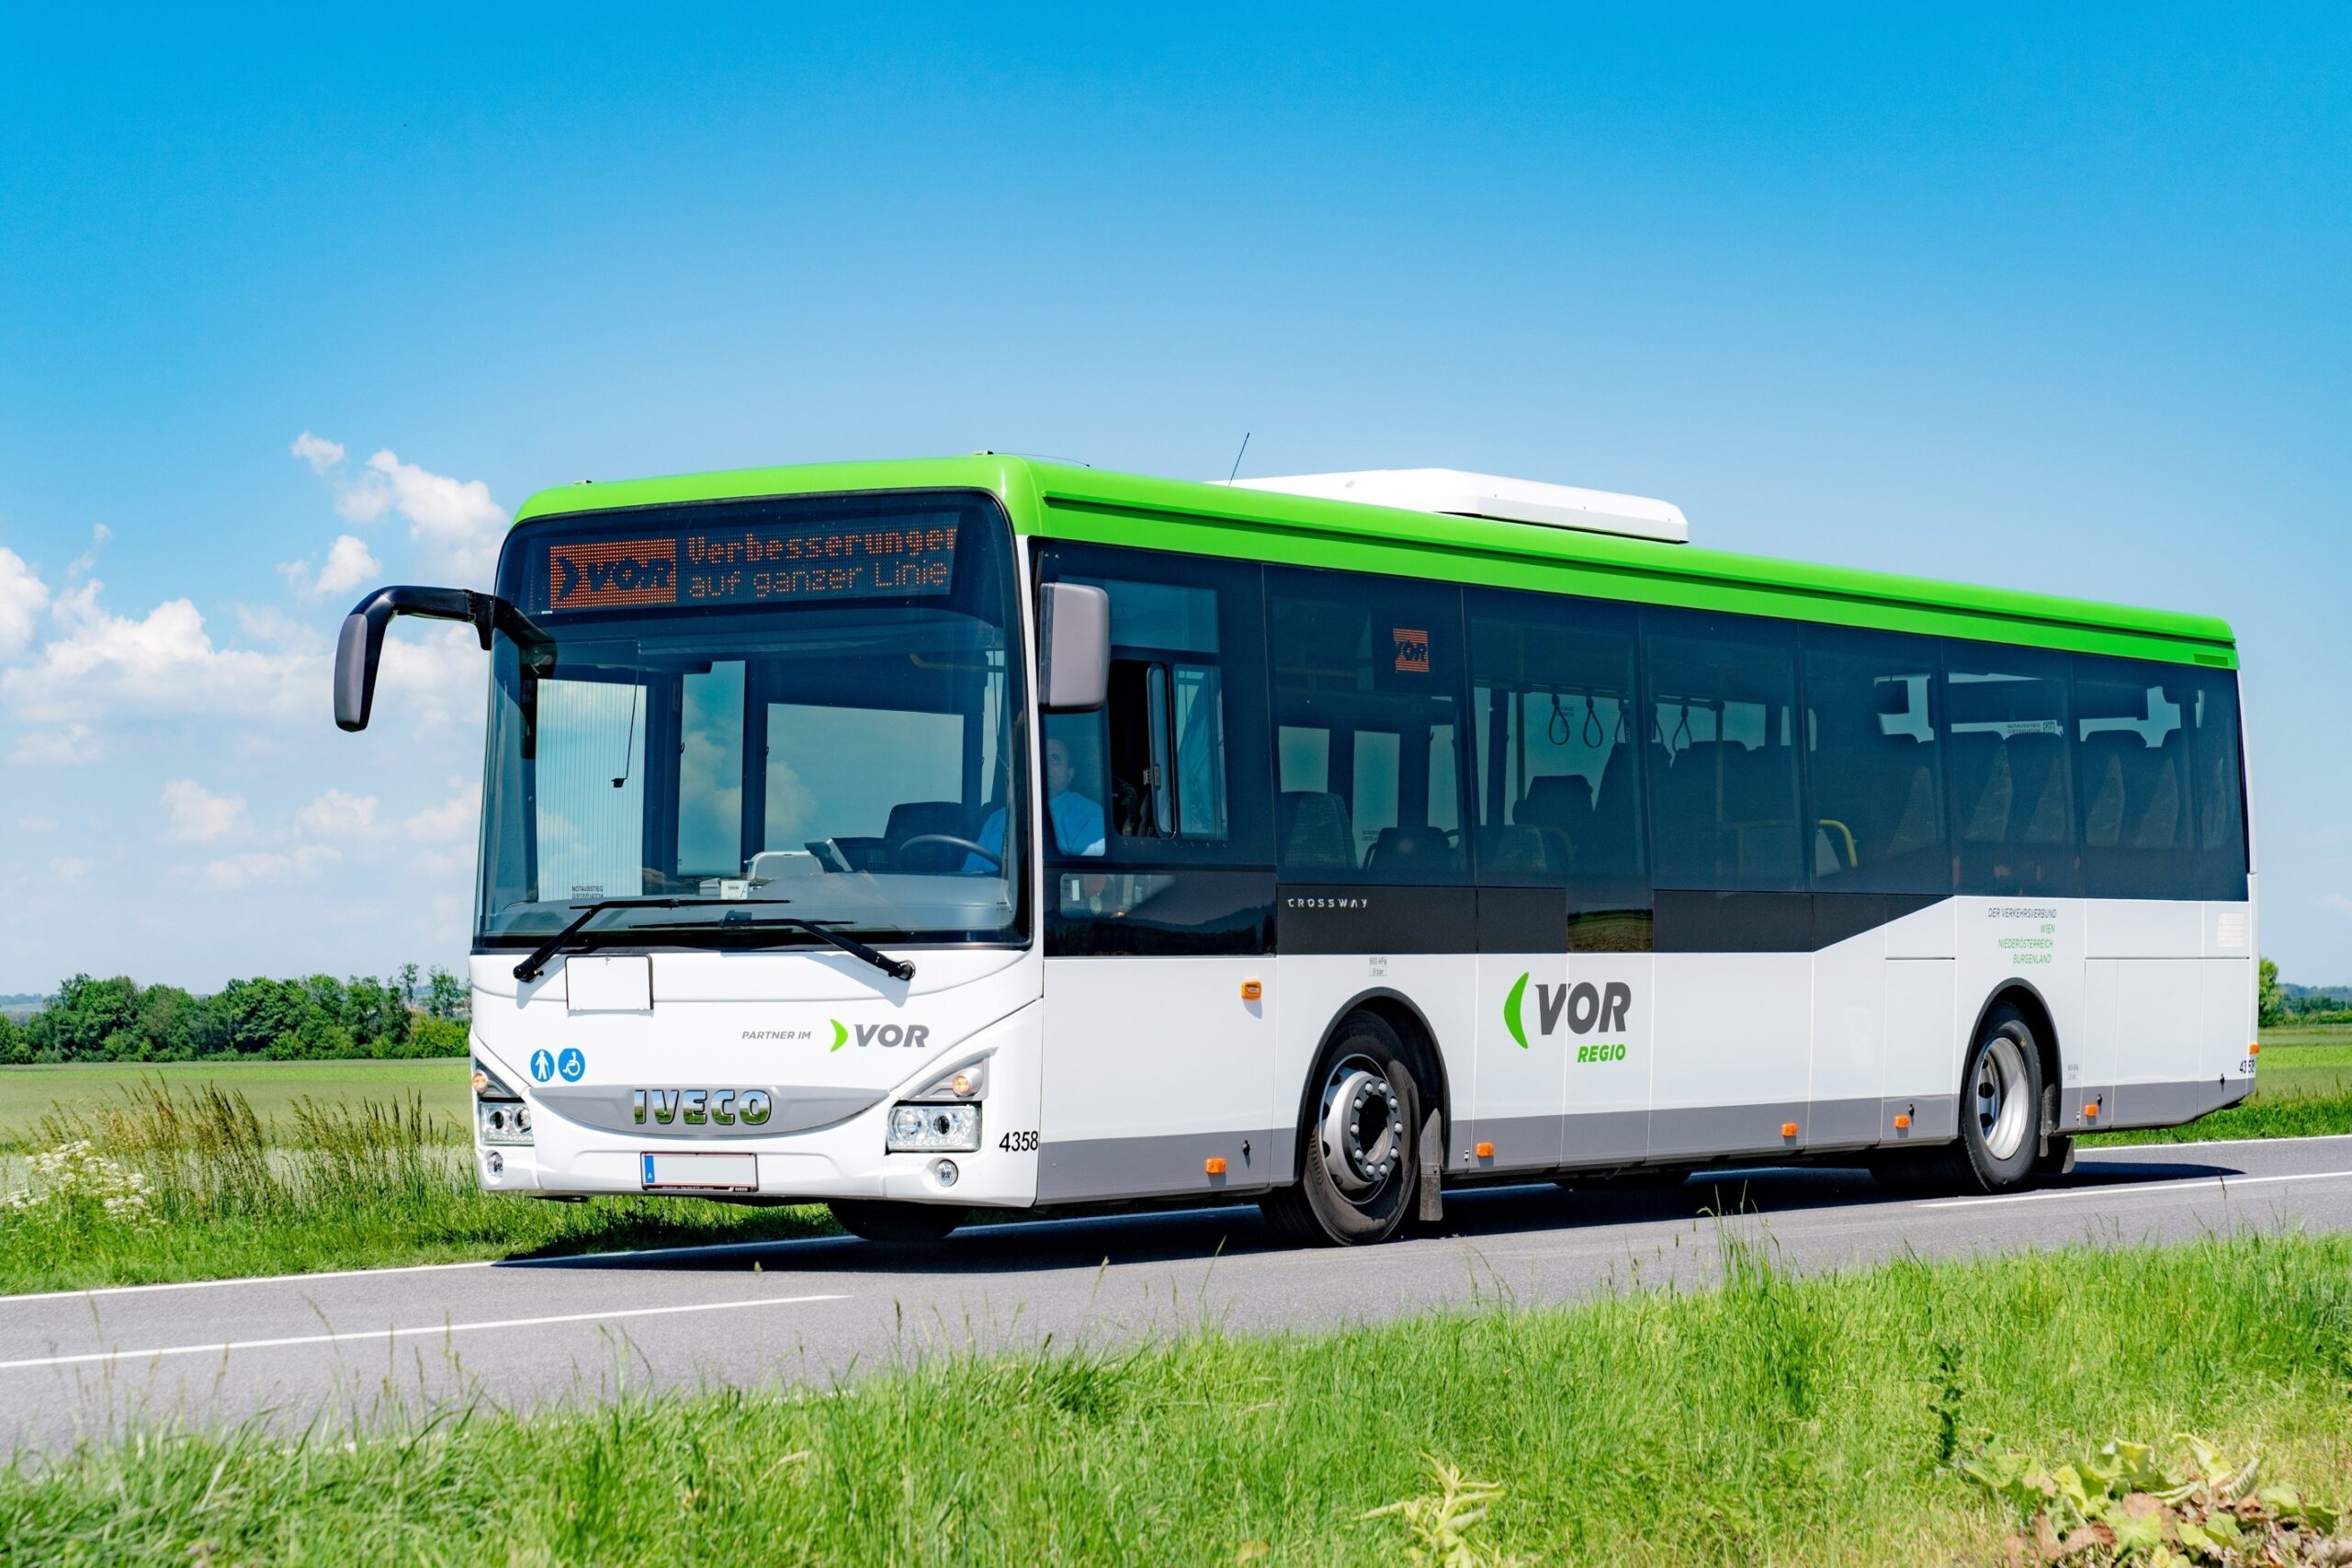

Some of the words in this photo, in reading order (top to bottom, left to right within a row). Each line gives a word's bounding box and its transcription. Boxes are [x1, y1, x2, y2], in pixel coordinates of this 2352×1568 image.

[586, 555, 672, 592] VOR
[688, 570, 741, 597] auf
[752, 566, 863, 598] ganzer
[875, 558, 948, 587] Linie
[1287, 898, 1368, 908] CROSSWAY
[1988, 908, 2001, 918] DER
[2002, 908, 2057, 919] VERKEHRSVERBUND
[2040, 923, 2055, 934] WIEN
[1998, 937, 2053, 948] NIEDERÖSTERREICH
[2013, 953, 2051, 964] BURGENLAND
[1535, 982, 1632, 1036] VOR
[741, 1031, 795, 1040] PARTNER
[797, 1031, 811, 1040] IM
[854, 1023, 930, 1048] VOR
[1577, 1043, 1626, 1064] REGIO
[2239, 1059, 2255, 1074] 4358
[632, 1089, 773, 1125] IVECO
[999, 1131, 1038, 1153] 4358
